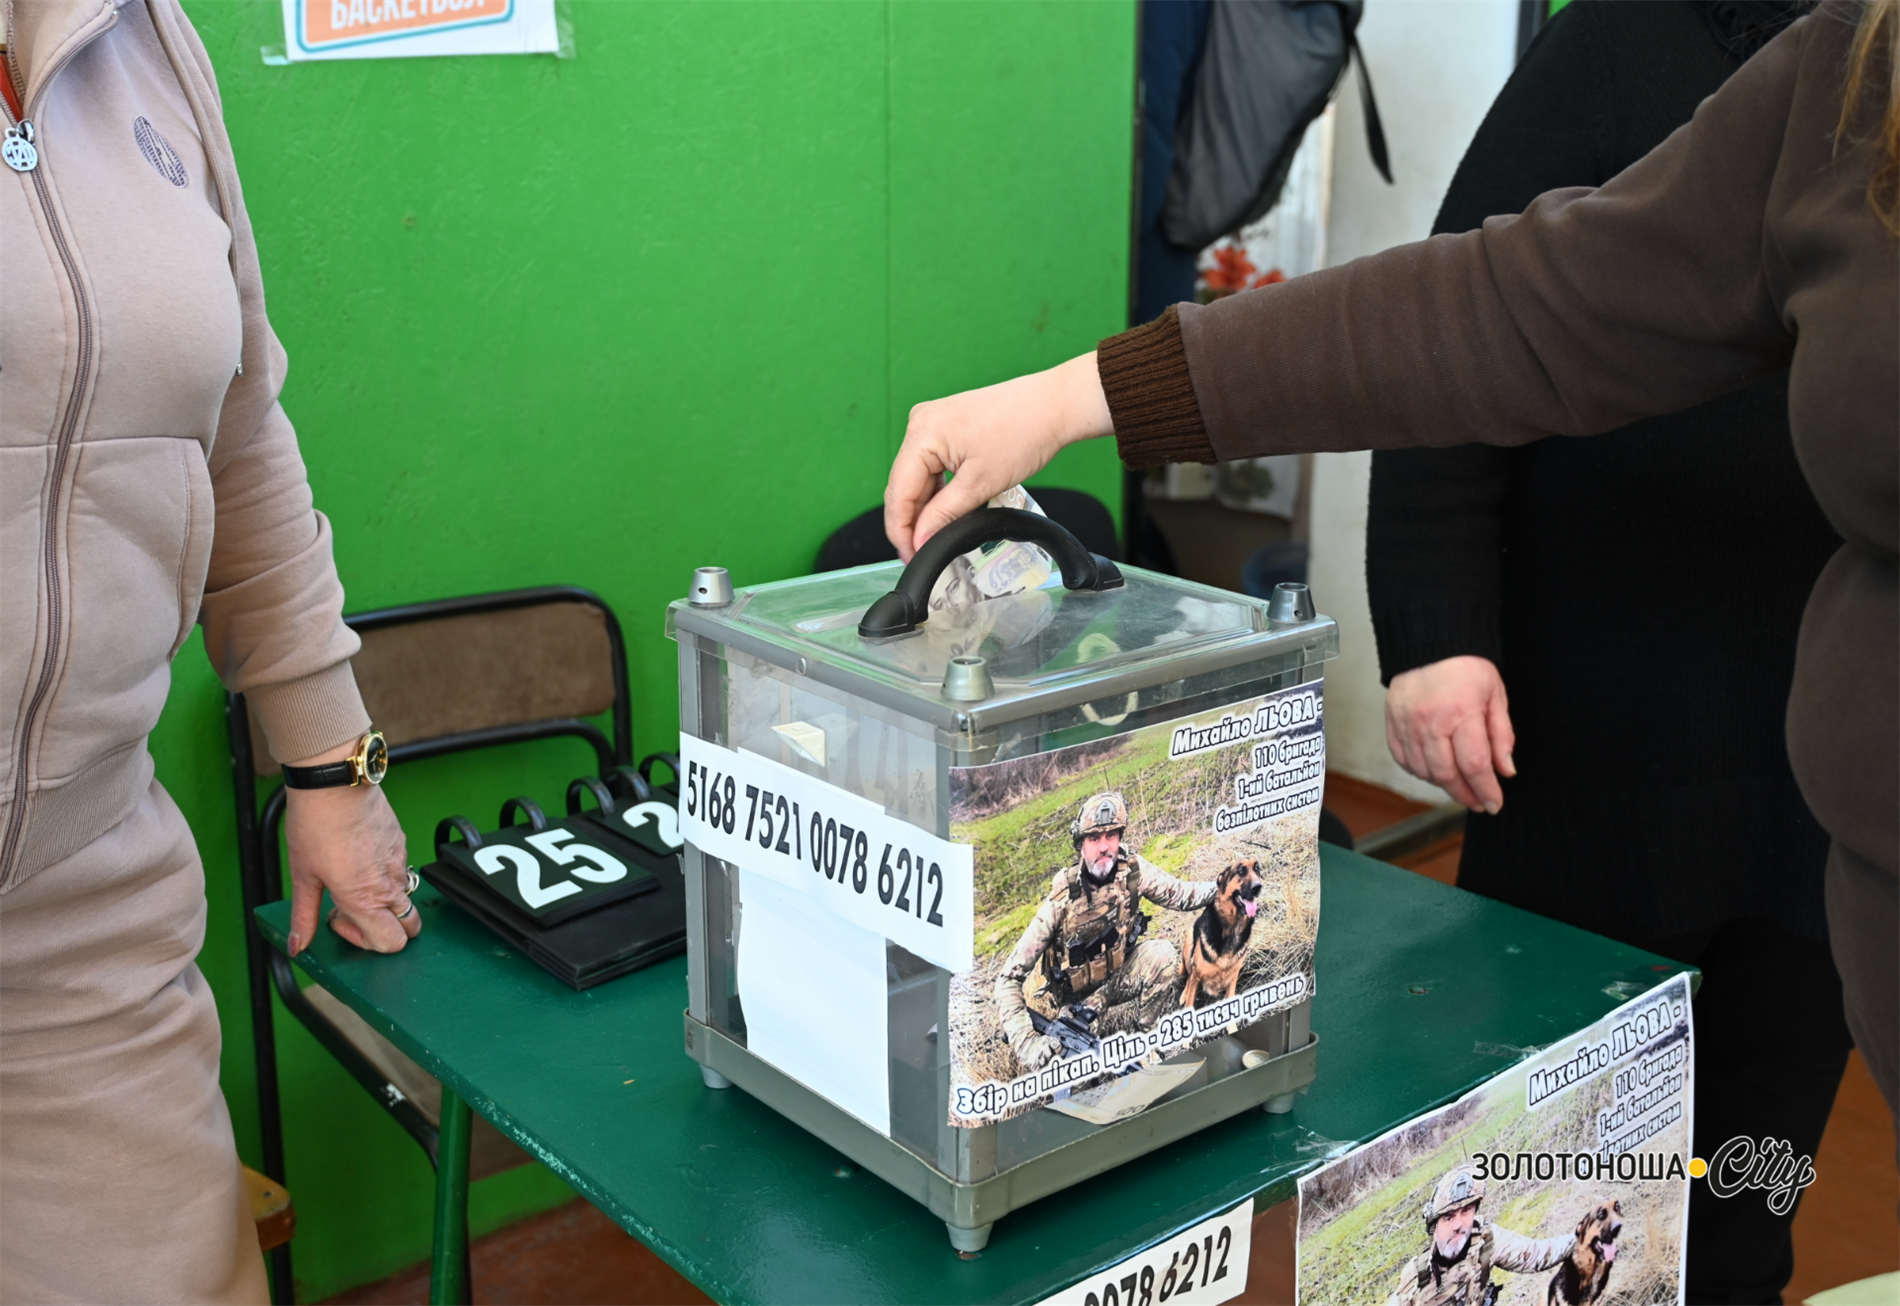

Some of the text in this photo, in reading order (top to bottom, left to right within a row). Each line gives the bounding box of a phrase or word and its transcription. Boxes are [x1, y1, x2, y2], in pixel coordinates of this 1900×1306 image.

[1172, 717, 1251, 756] Михайло
[1253, 696, 1315, 735] ЛЬОВА
[1255, 735, 1322, 769] 110 бригада
[1216, 785, 1320, 833] безпілотних систем
[1238, 760, 1320, 800] 1-ий батальйон
[473, 828, 628, 909] 25
[687, 760, 944, 928] 5168 7521 0078 6212
[956, 1083, 1008, 1115] Збір
[1012, 1075, 1037, 1103] на
[1041, 1054, 1100, 1093] пікап.
[1103, 1033, 1147, 1069] Ціль
[1160, 1011, 1195, 1047] 285
[1197, 999, 1240, 1033] тисяч
[1243, 976, 1305, 1018] гривень
[1529, 1043, 1610, 1106] Михайло
[1612, 1001, 1672, 1060] ЛЬОВА
[1615, 1044, 1682, 1099] 110 бригада
[1599, 1072, 1682, 1138] 1-ий батальйон
[1646, 1101, 1681, 1138] систем
[1158, 1225, 1232, 1303] 6212
